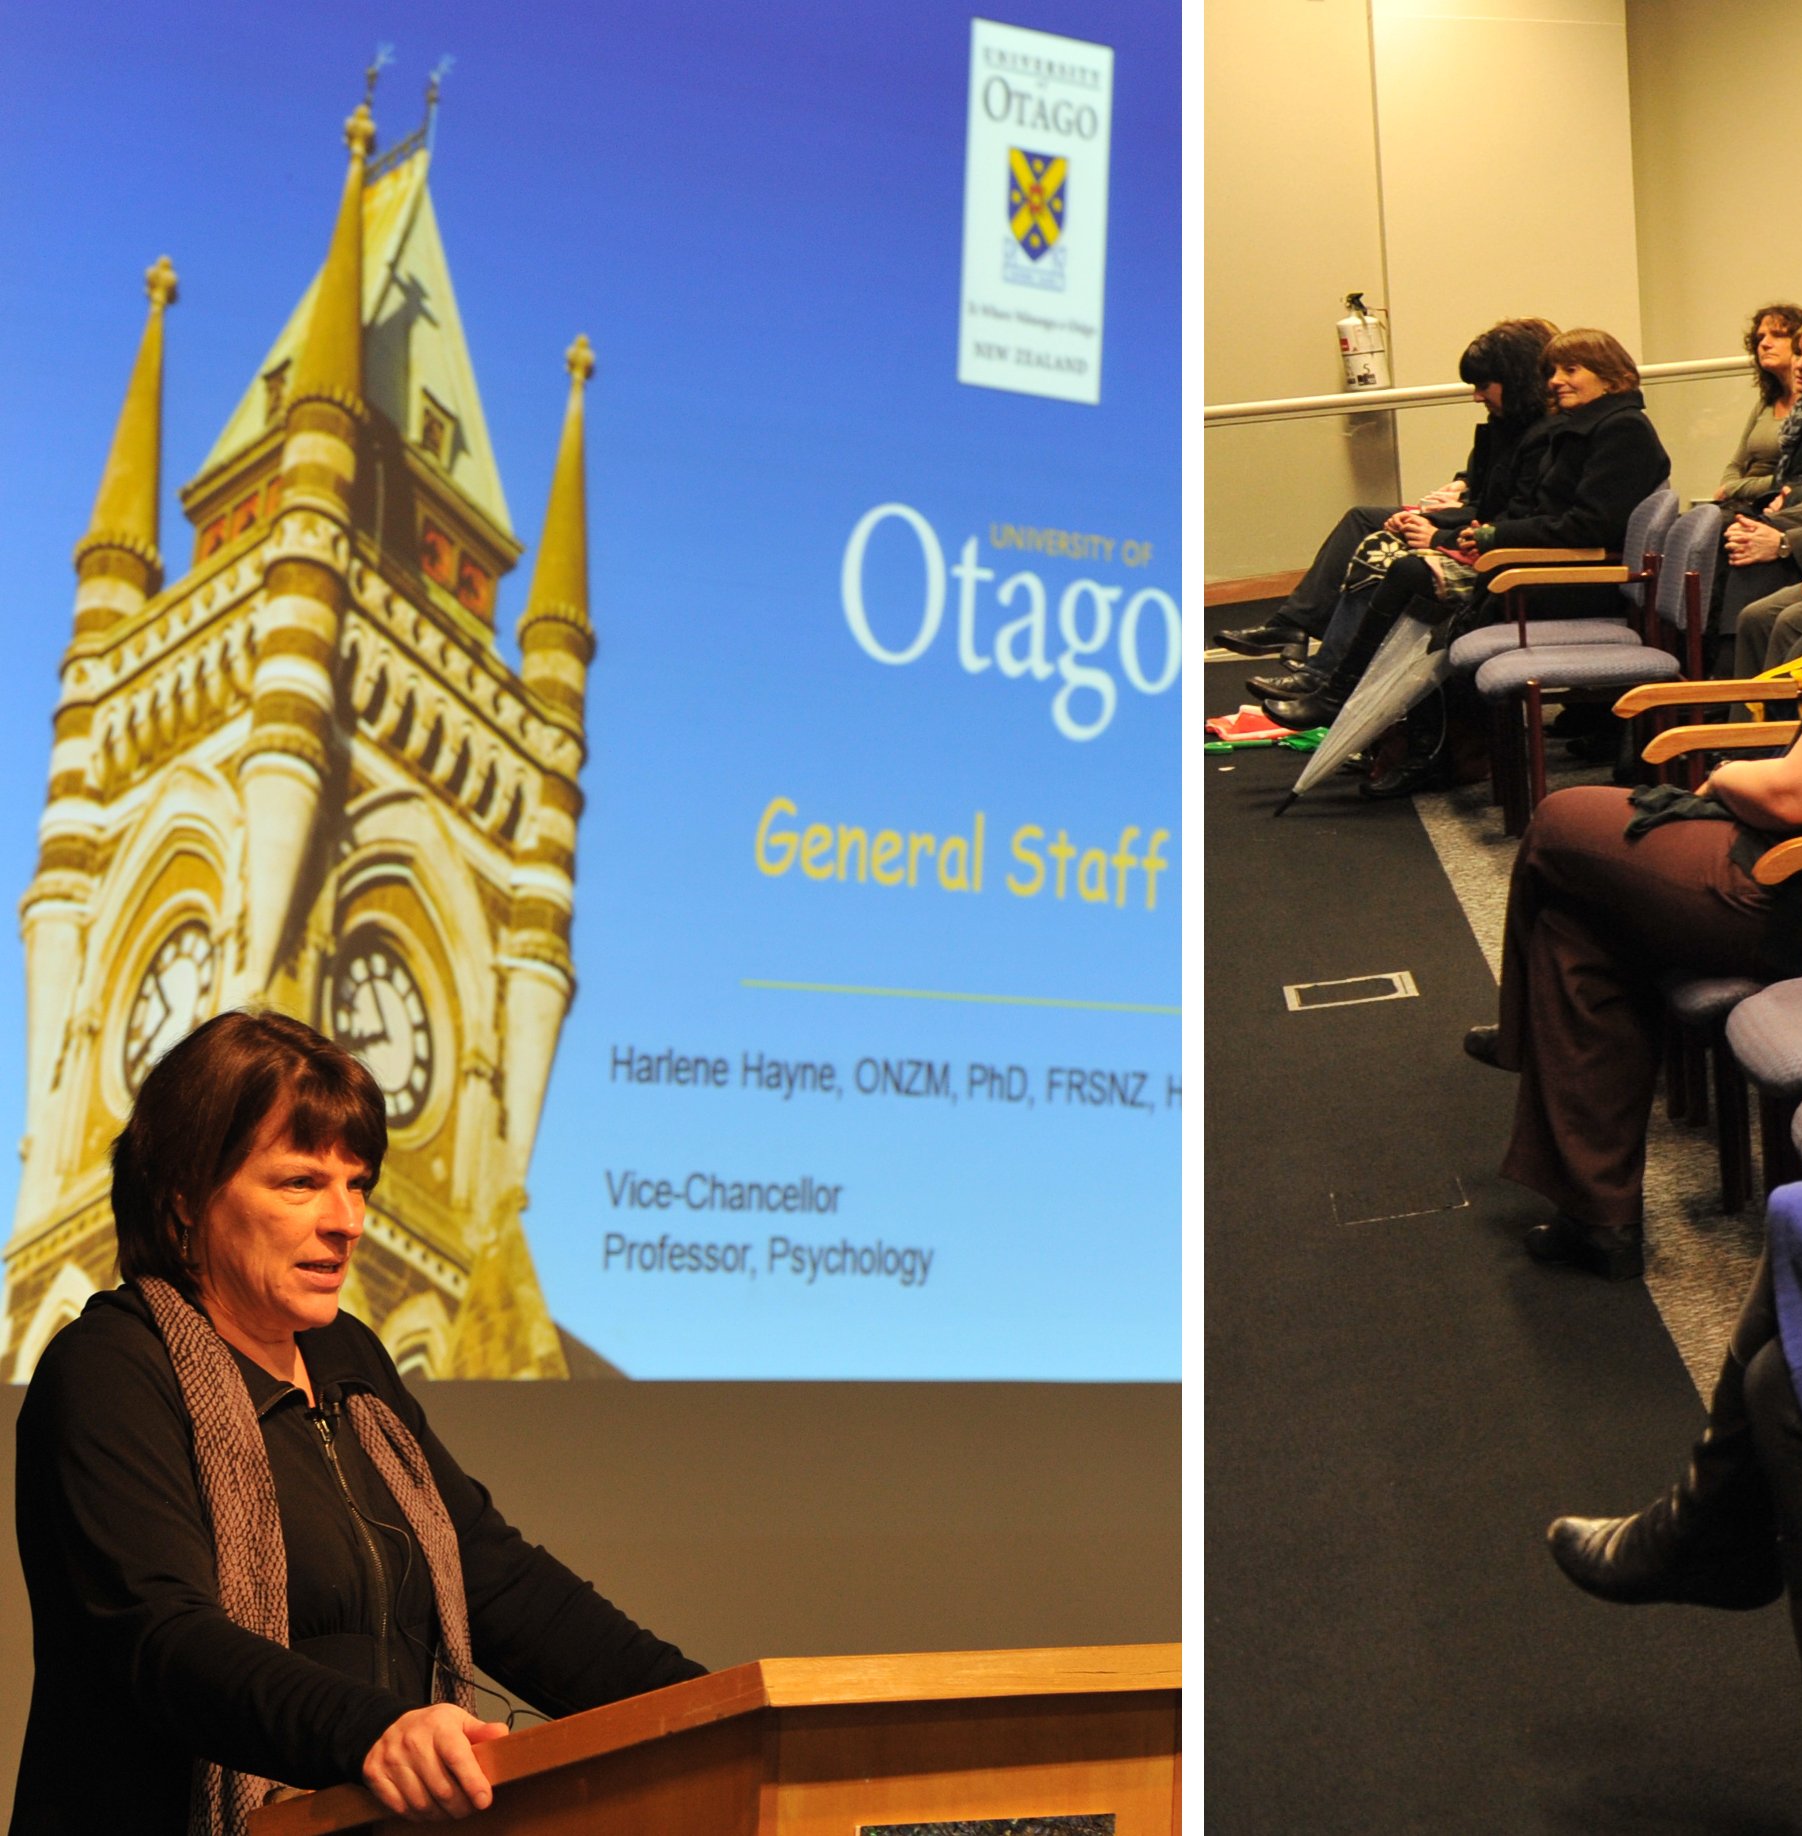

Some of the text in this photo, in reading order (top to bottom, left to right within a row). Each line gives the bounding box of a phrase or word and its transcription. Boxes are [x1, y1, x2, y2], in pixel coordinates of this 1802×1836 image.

[982, 75, 1099, 140] OTAGO
[990, 522, 1152, 567] UNIVERSITY OF
[841, 502, 1181, 742] Otago
[755, 797, 1171, 910] General Staff
[611, 1046, 729, 1088] Harlene
[742, 1051, 842, 1101] Hayne,
[854, 1057, 958, 1106] ONZM,
[967, 1063, 1034, 1109] PhD,
[1047, 1067, 1154, 1115] FRSNZ,
[605, 1169, 843, 1214] Vice-Chancellor
[603, 1233, 934, 1286] Professor, Psychology
